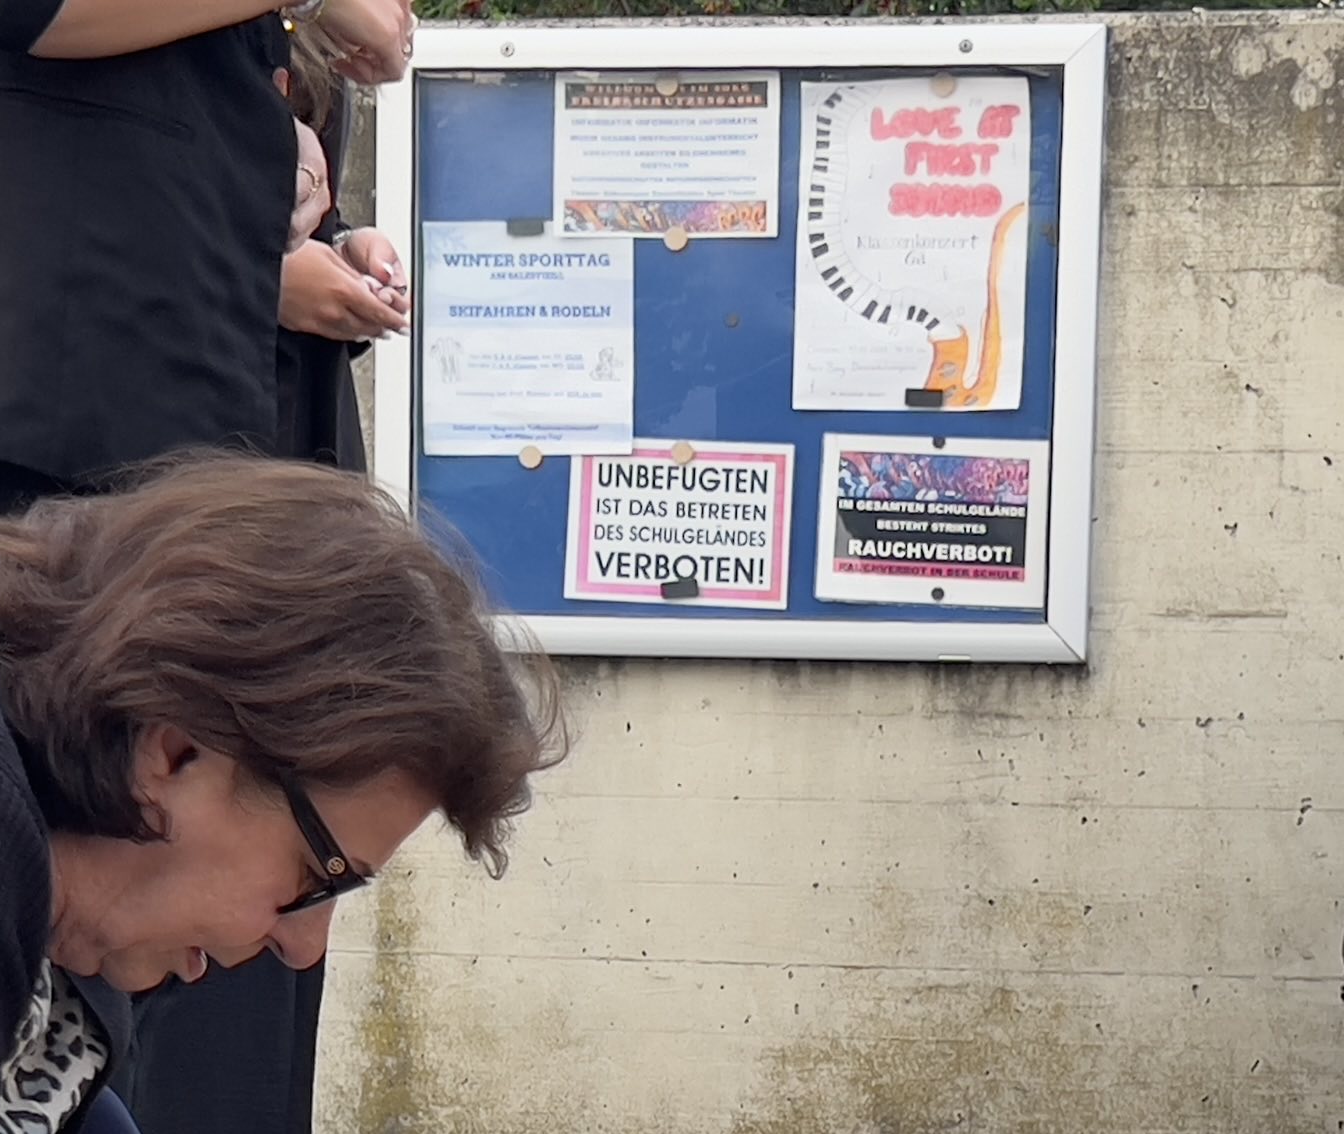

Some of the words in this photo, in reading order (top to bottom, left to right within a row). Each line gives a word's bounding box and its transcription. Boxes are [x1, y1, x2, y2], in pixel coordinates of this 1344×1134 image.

[870, 107, 962, 140] LOVE
[977, 105, 1021, 138] AT
[905, 141, 999, 176] FIRST
[443, 253, 514, 268] WINTER
[519, 253, 610, 268] SPORTTAG
[449, 305, 535, 319] SKIFAHREN
[540, 305, 548, 318] &
[552, 305, 611, 319] RODELN
[598, 463, 768, 494] UNBEFUGTEN
[596, 498, 621, 515] IST
[629, 500, 668, 517] DAS
[676, 502, 766, 521] BETRETEN
[838, 500, 854, 510] IM
[857, 501, 924, 513] GESAMTEN
[927, 503, 1025, 517] SCHULGELÄNDE
[594, 524, 624, 541] DES
[629, 526, 766, 547] SCHULGELÄNDES
[848, 539, 1012, 563] RAUCHVERBOT!
[595, 551, 764, 584] VERBOTEN!
[930, 567, 943, 576] IN
[973, 569, 1020, 580] SCHULE
